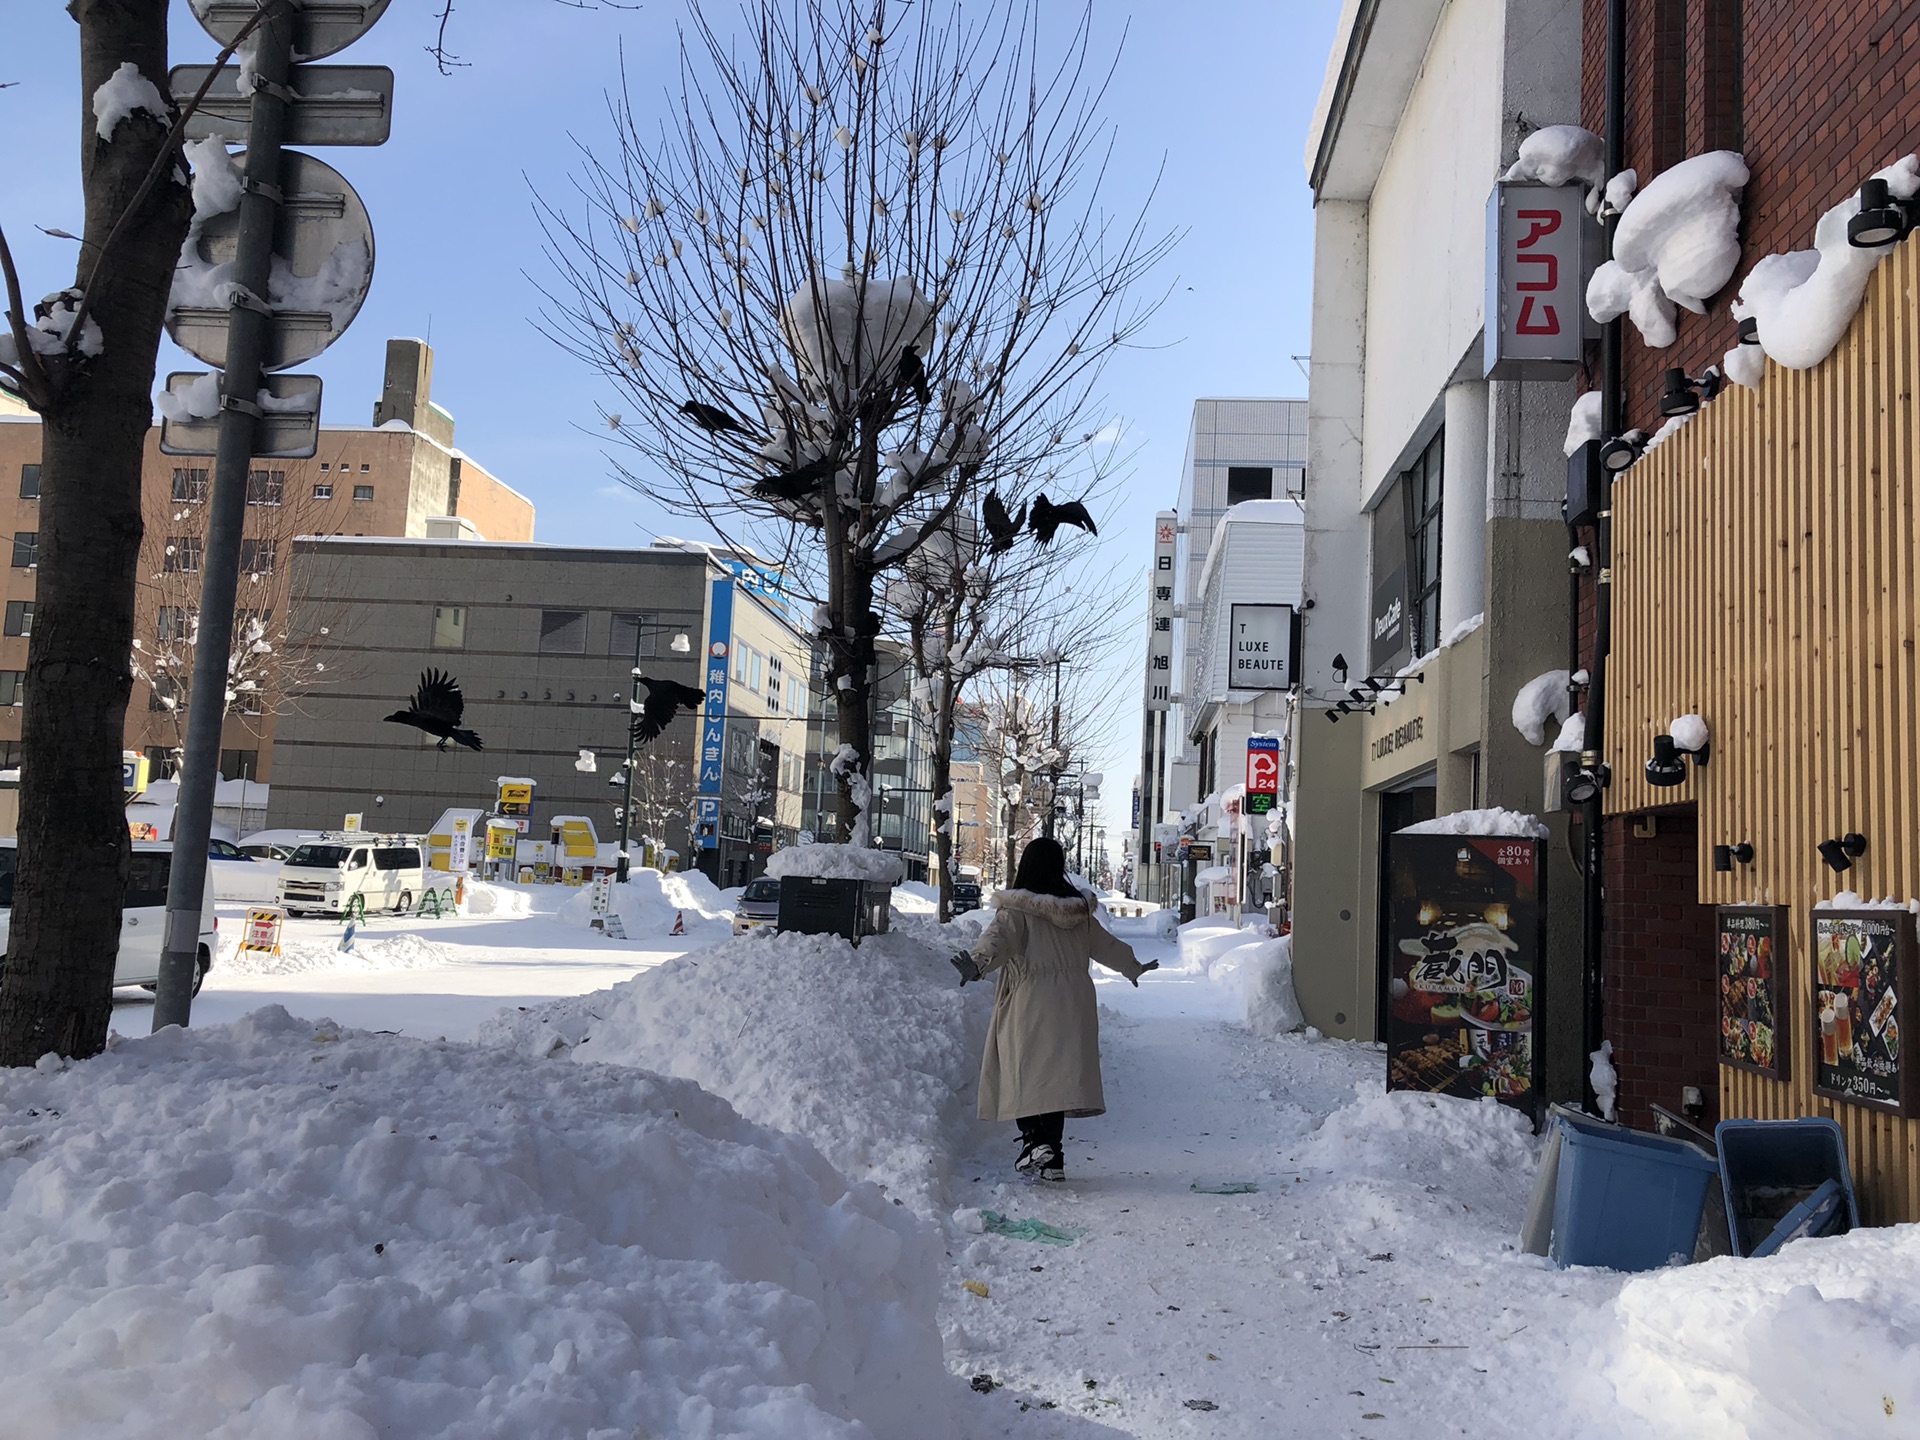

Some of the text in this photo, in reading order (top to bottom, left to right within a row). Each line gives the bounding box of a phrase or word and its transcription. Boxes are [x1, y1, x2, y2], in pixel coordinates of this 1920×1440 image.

[1516, 210, 1562, 335] アコム
[1239, 623, 1246, 634] T
[1239, 641, 1269, 652] LUXE
[1238, 658, 1284, 671] BEAUTE
[703, 669, 725, 781] 稚内しんきん
[1250, 740, 1277, 748] System
[1258, 778, 1276, 789] 24
[702, 801, 716, 816] P
[1252, 794, 1271, 812] 空
